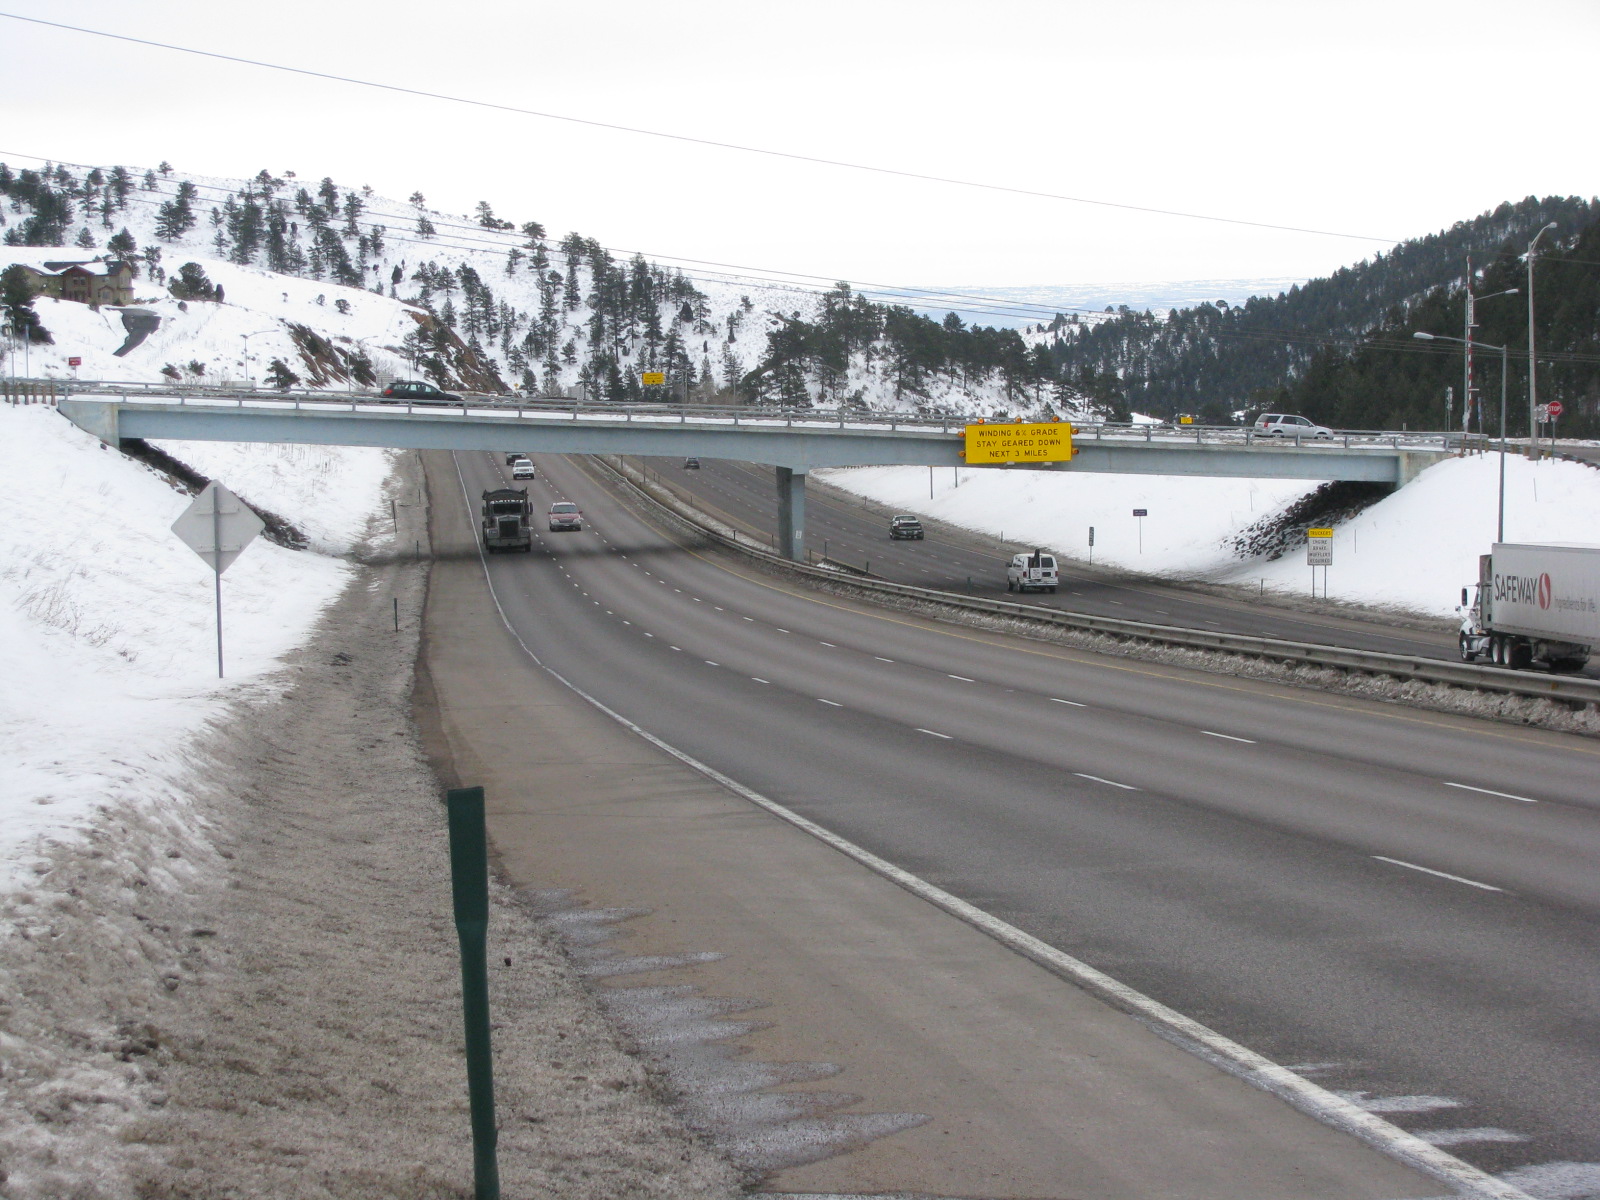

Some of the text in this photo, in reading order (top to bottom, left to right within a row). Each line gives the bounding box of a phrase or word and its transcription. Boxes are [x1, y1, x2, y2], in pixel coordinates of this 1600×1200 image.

[1038, 438, 1061, 446] DOWN
[989, 450, 1010, 458] NEXT
[1015, 449, 1020, 457] 3
[1495, 574, 1537, 605] SAFEWAY
